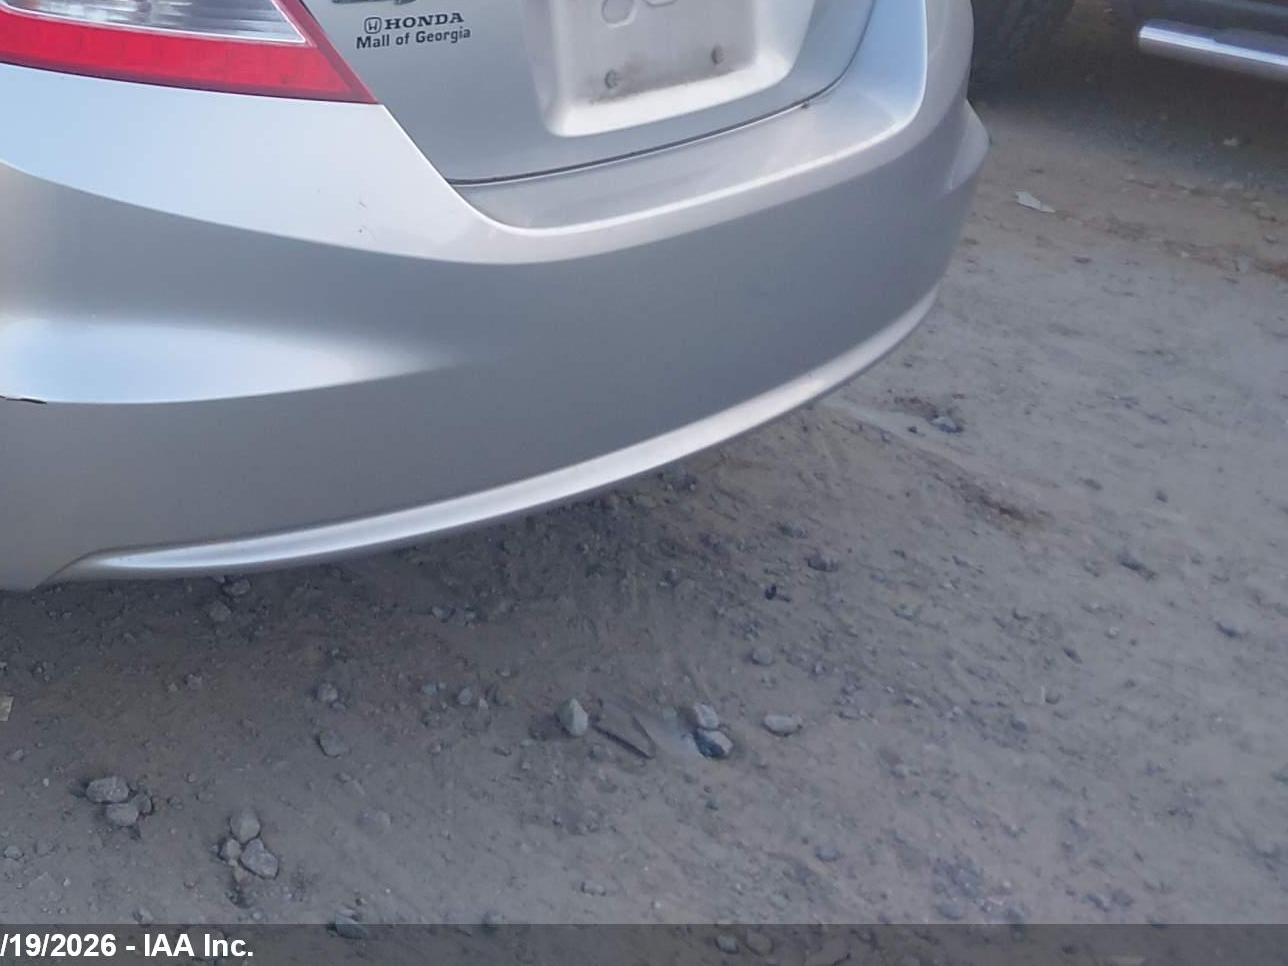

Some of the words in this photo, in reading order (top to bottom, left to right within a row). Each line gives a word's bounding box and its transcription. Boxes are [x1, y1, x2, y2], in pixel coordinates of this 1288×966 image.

[385, 12, 464, 30] HONDA
[356, 36, 390, 49] Mall
[396, 32, 411, 46] of
[415, 26, 471, 44] Georgia
